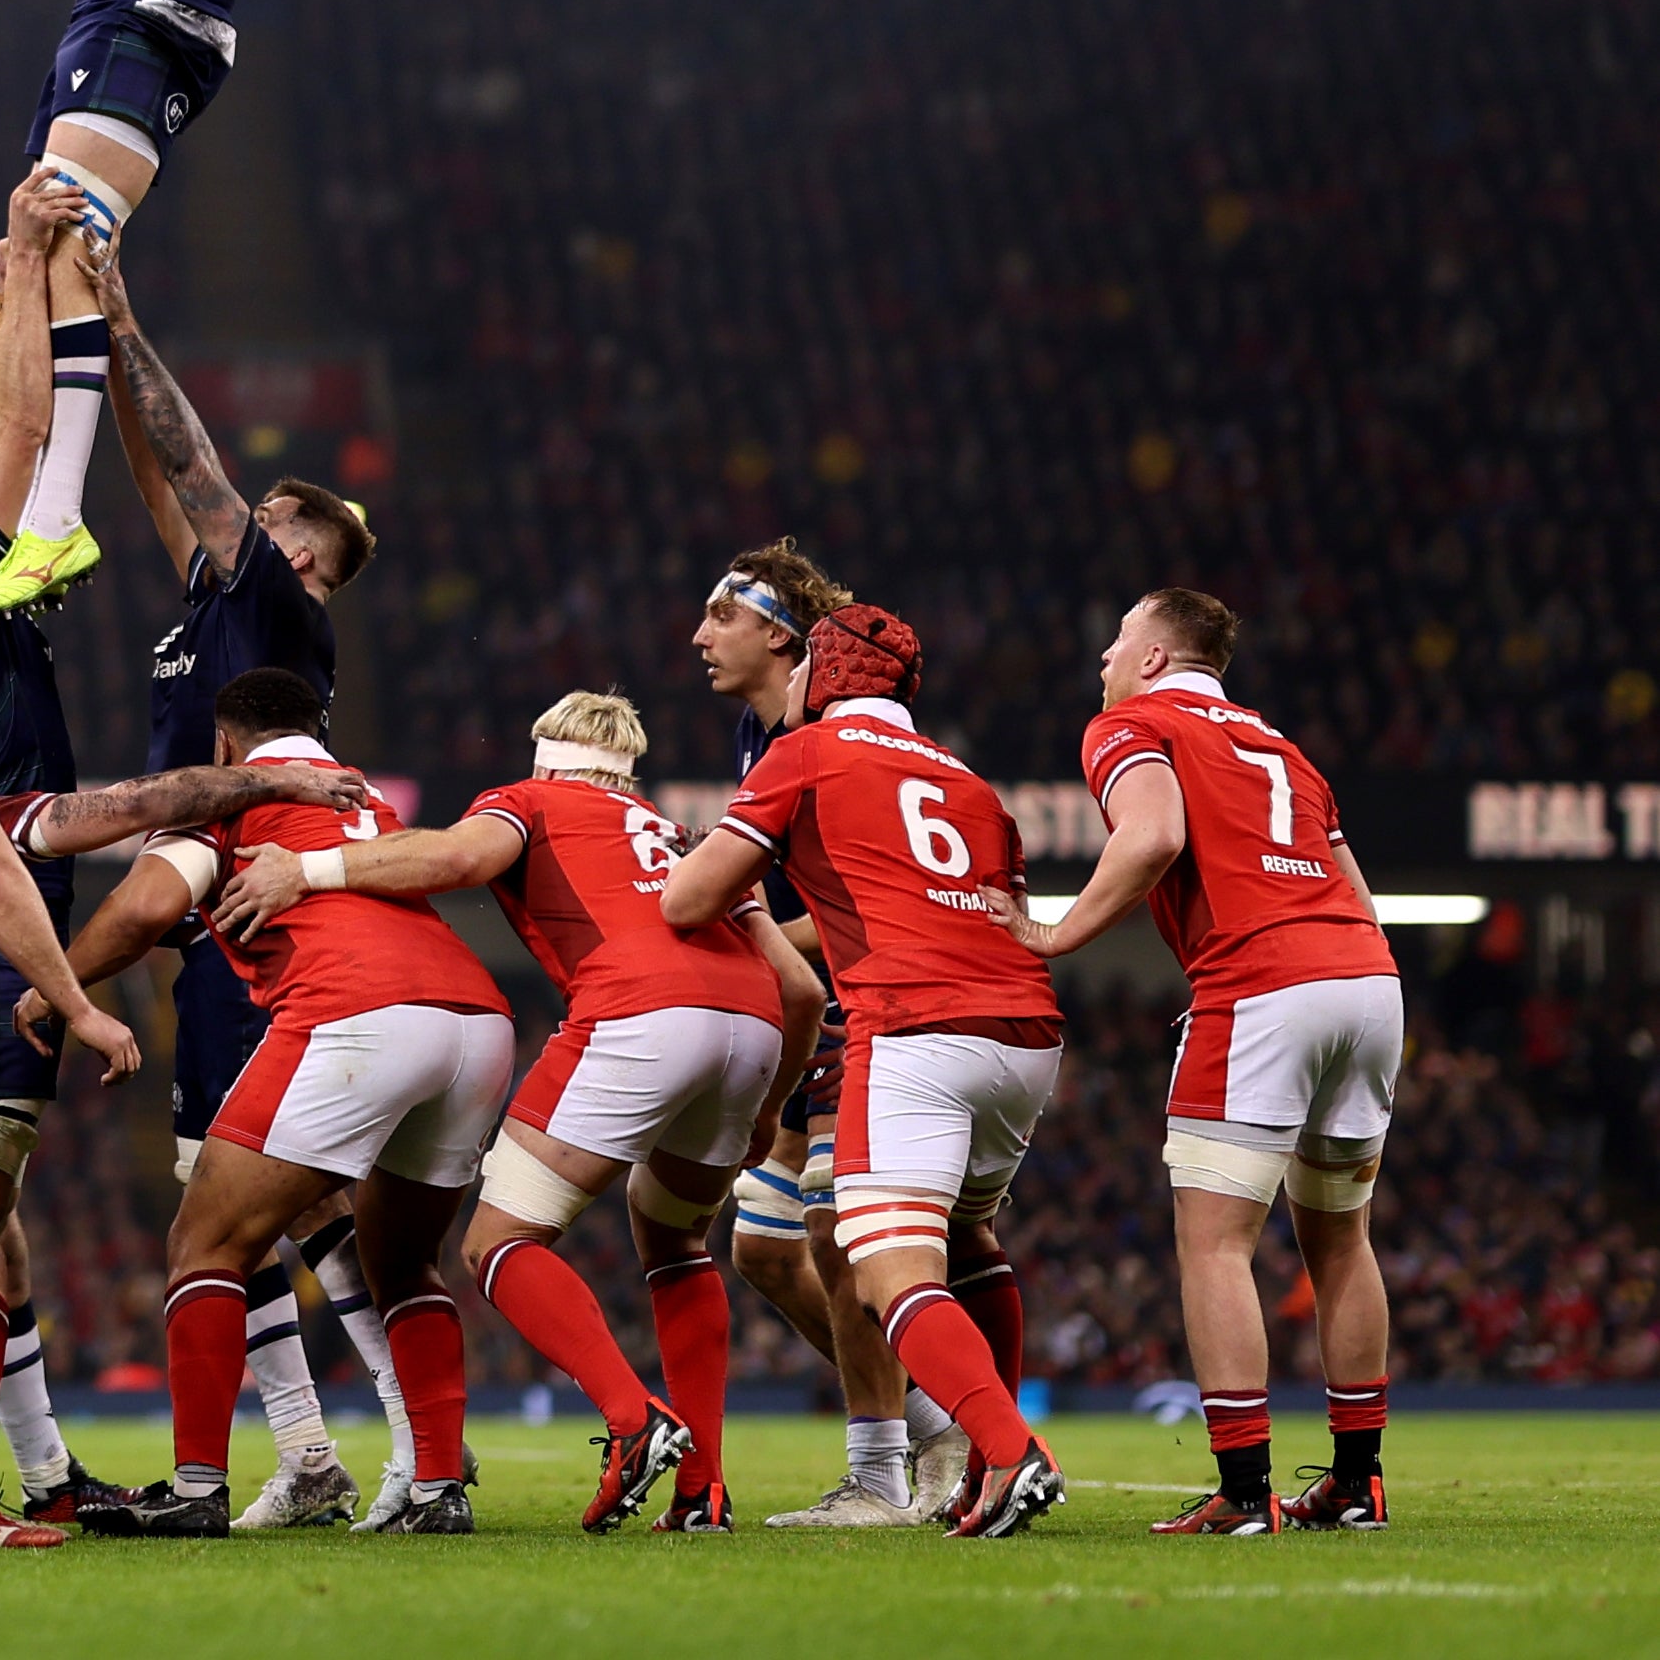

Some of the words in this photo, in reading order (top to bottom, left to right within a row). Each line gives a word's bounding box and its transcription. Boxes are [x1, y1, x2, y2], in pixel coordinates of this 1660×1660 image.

[898, 777, 972, 879] 6
[1229, 741, 1295, 847] 7
[624, 806, 682, 873] 8
[1260, 854, 1328, 879] REFFELL
